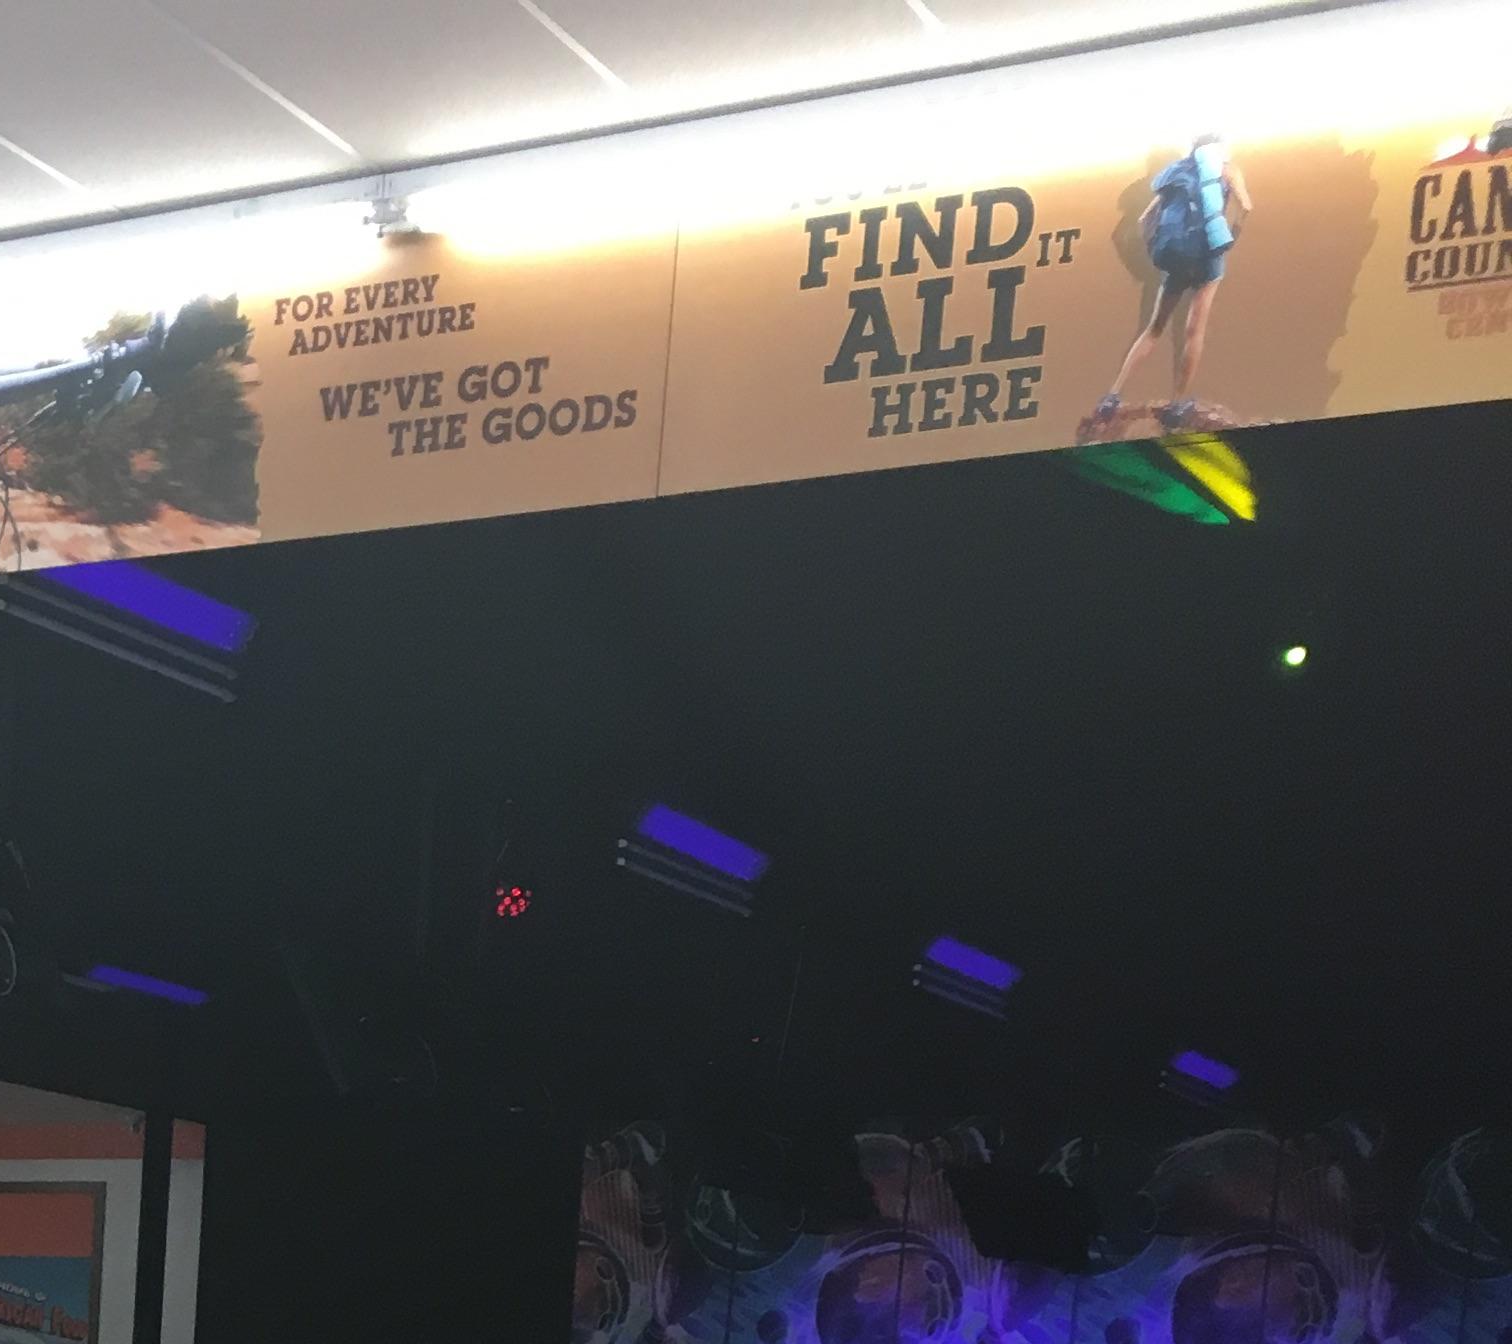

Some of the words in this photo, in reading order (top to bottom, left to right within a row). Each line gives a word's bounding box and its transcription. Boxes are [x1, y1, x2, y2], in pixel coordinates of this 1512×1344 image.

[799, 186, 1035, 290] FIND
[1036, 228, 1081, 269] IT
[275, 292, 332, 326] FOR
[344, 274, 440, 315] EVERY
[288, 303, 475, 356] ADVENTURE
[823, 265, 1045, 385] ALL
[320, 371, 443, 421] WE'VE
[457, 356, 549, 399] GOT
[867, 365, 1042, 438] HERE
[388, 414, 468, 457] THE
[481, 390, 637, 445] GOODS
